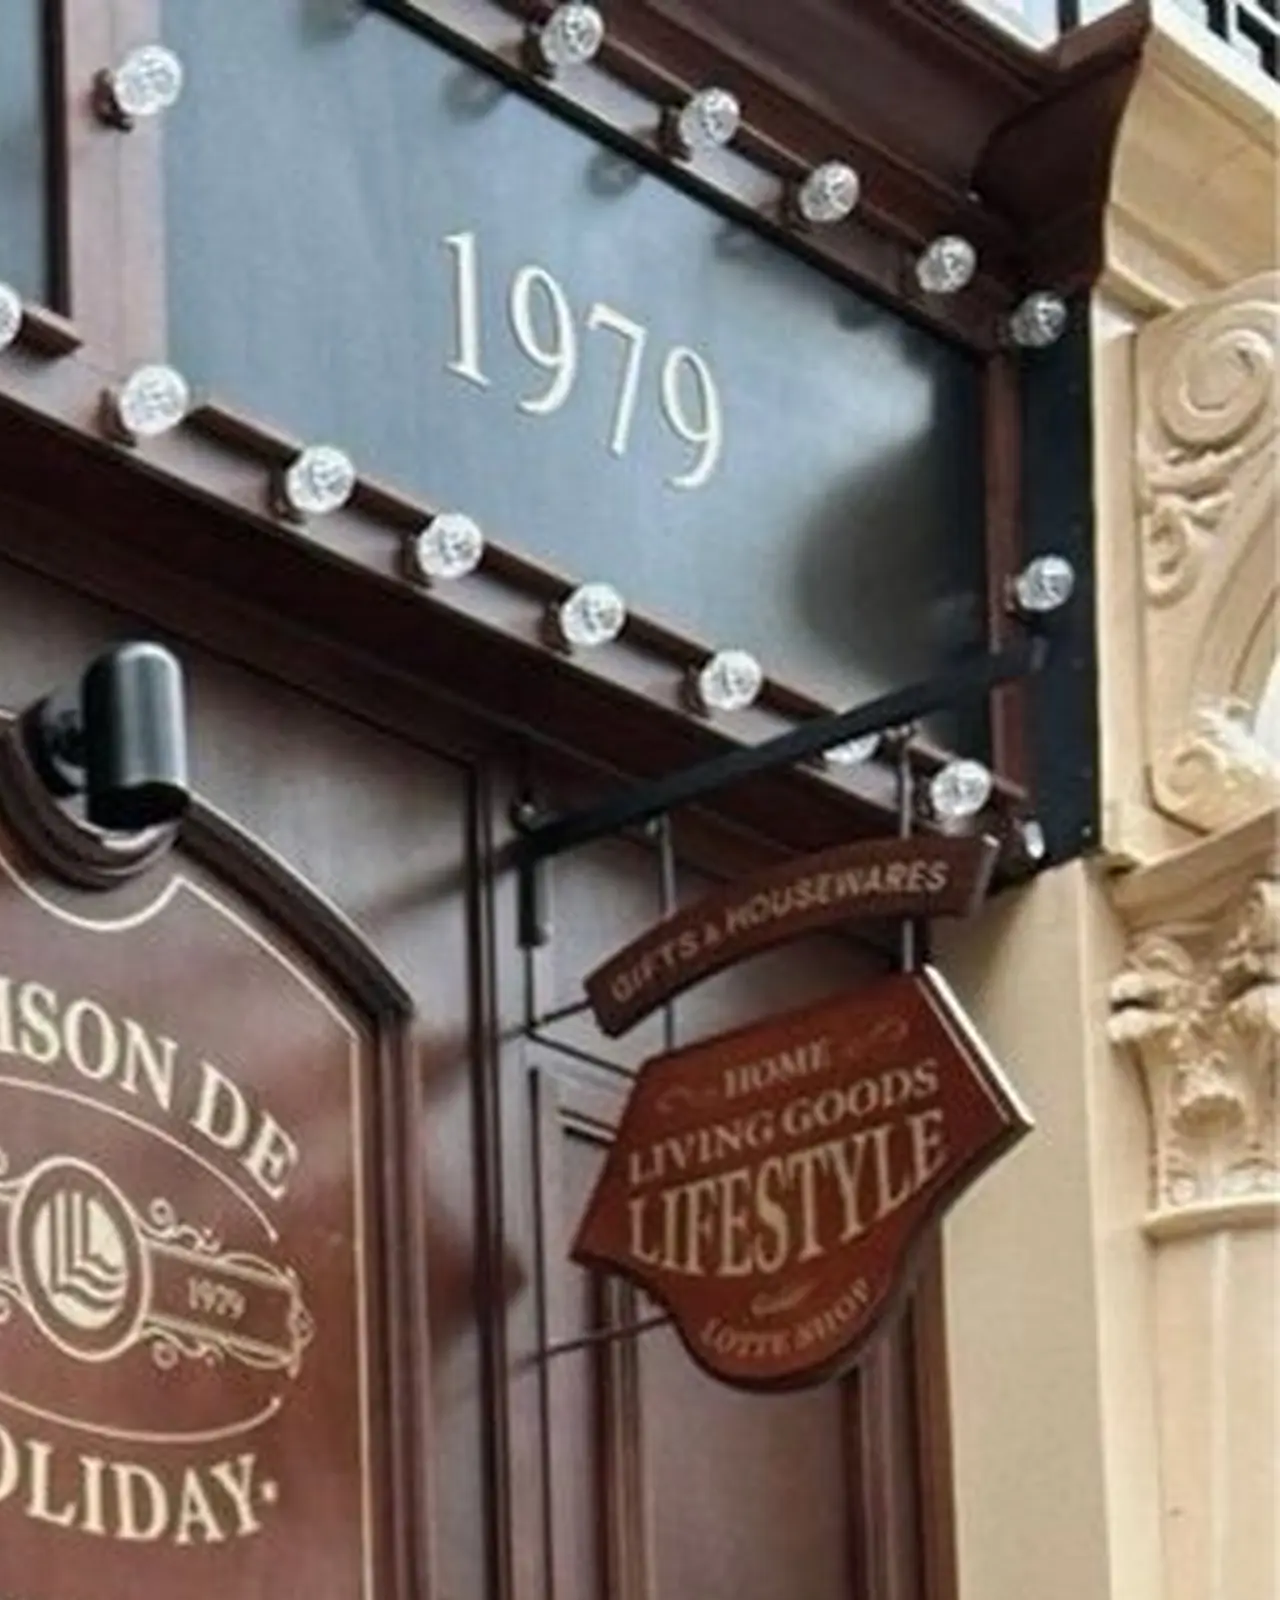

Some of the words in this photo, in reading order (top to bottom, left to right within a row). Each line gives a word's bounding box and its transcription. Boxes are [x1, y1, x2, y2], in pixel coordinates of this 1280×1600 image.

[442, 231, 721, 489] 1979
[193, 1062, 301, 1200] DE
[629, 1110, 775, 1185] LIVING
[782, 1057, 941, 1139] GOODS
[722, 1035, 830, 1099] HOME
[627, 1108, 945, 1279] LIFESTYLE
